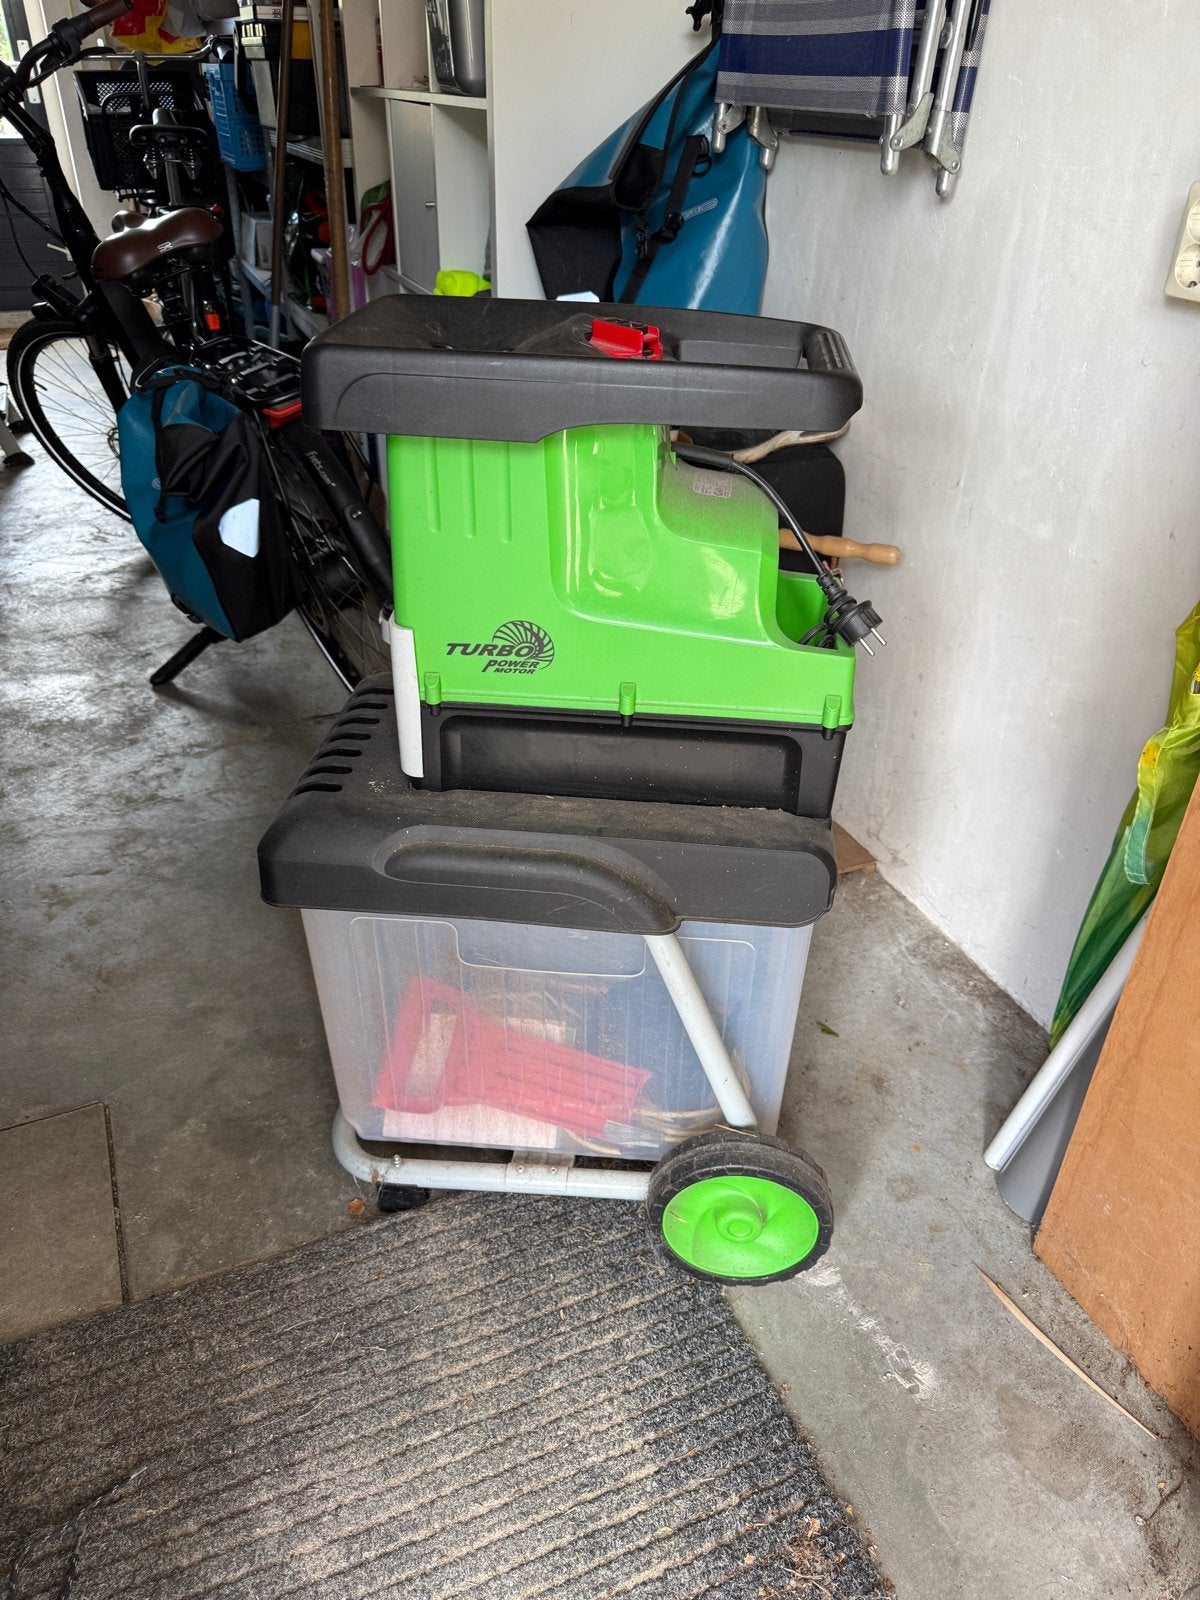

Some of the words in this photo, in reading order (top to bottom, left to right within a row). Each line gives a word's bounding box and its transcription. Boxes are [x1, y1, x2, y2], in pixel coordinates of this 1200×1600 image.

[446, 643, 534, 658] TURBO
[481, 659, 540, 673] POWER
[493, 667, 536, 675] MOTOR
